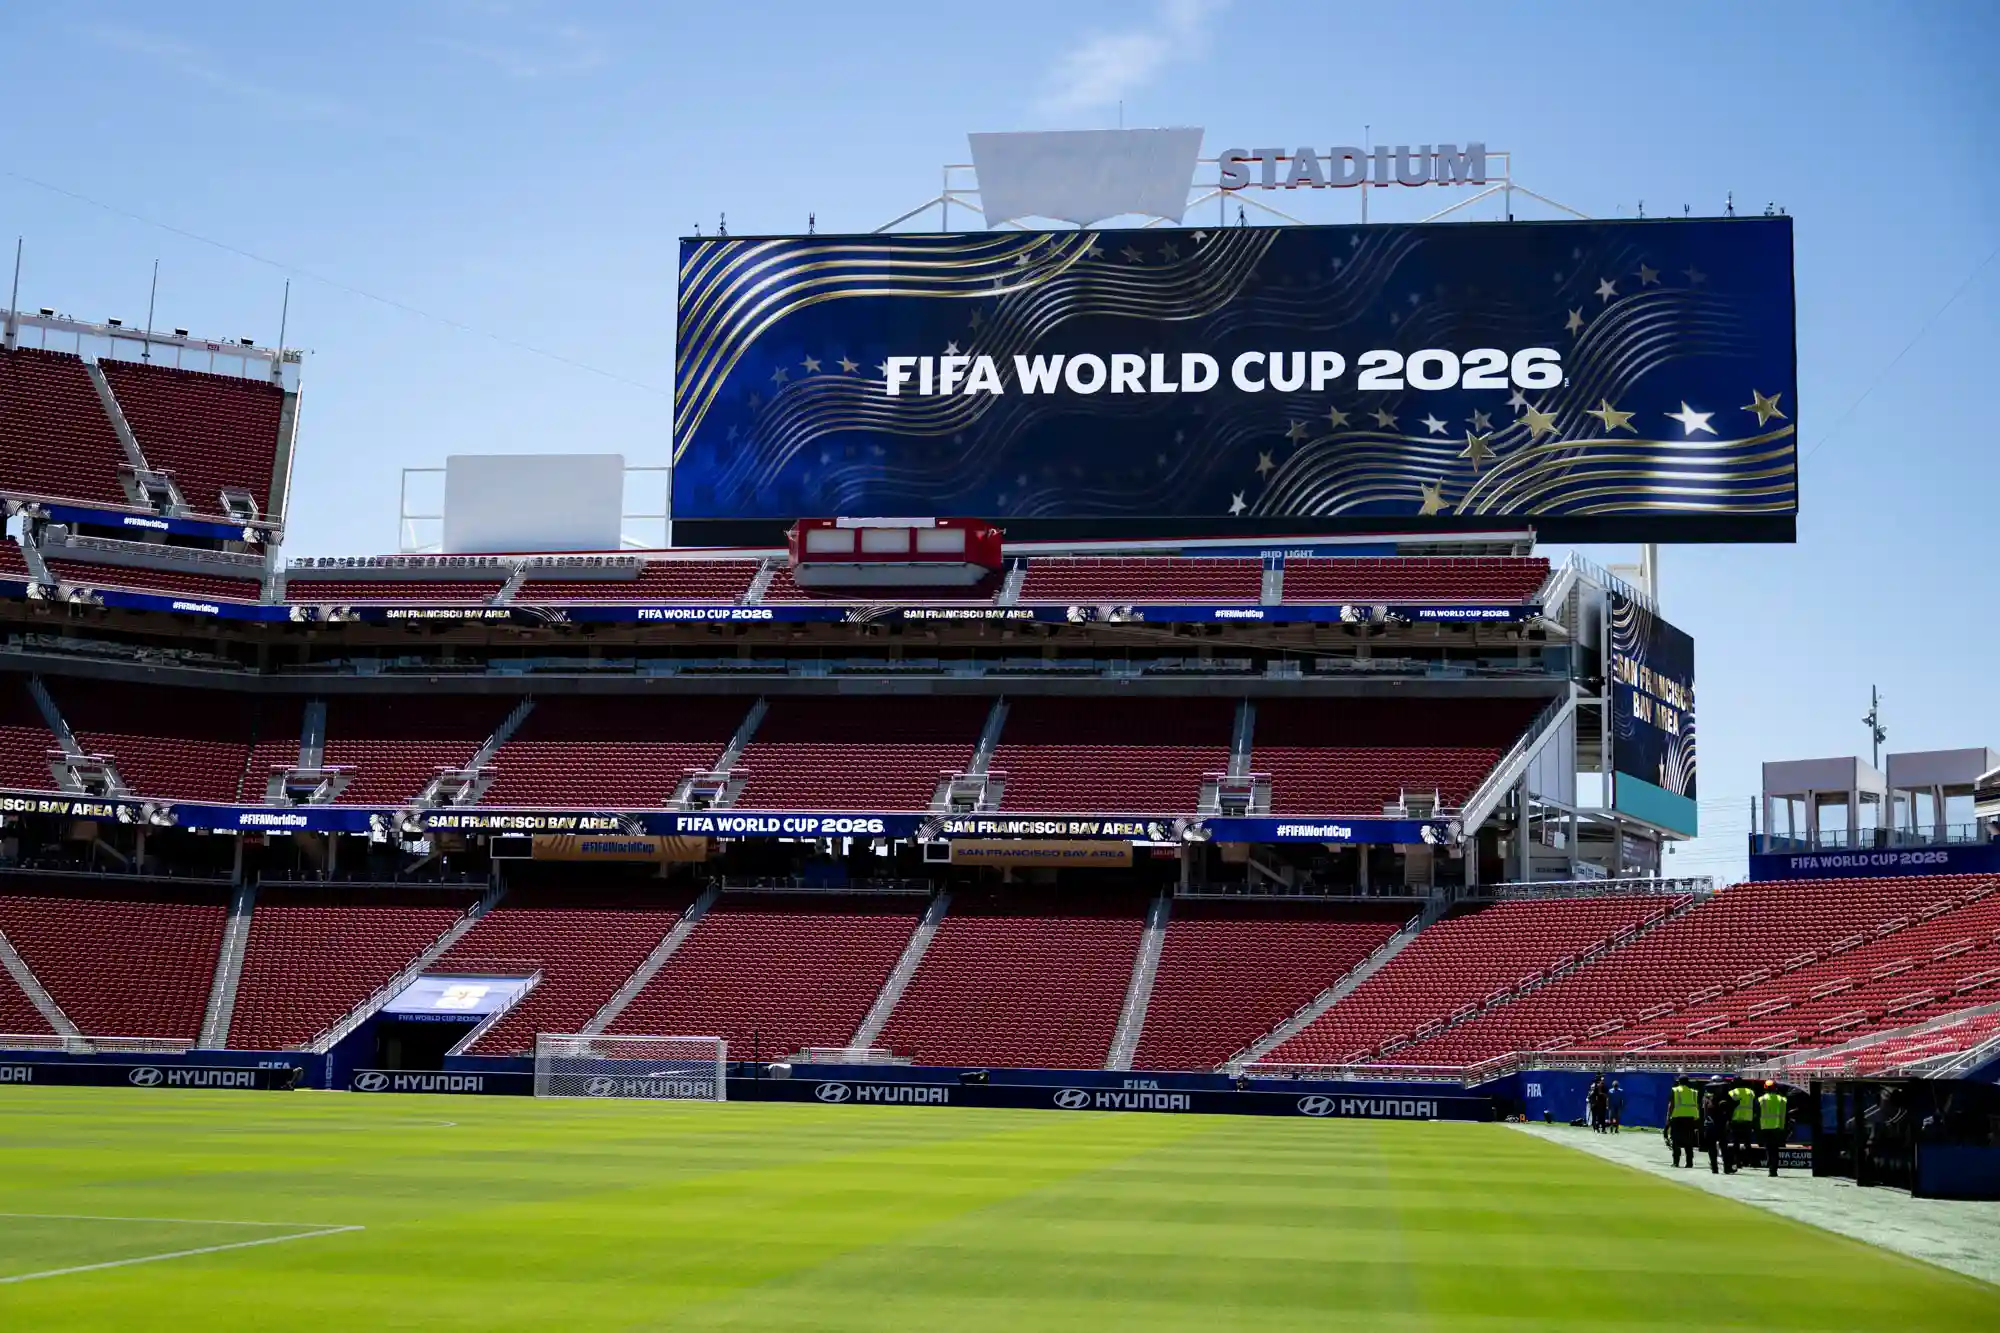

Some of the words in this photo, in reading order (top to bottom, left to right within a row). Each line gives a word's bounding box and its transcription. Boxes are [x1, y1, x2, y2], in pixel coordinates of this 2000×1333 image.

[1219, 141, 1486, 190] STADIUM
[886, 355, 1004, 395] FIFA
[1013, 353, 1220, 394] WORLD
[1231, 350, 1346, 392] CUP
[1357, 347, 1563, 391] 2026
[123, 517, 169, 530] #FIFAWorldCup
[172, 601, 219, 614] #FIFAWorldCup
[387, 610, 407, 618] SAN
[408, 610, 462, 619] FRANCISCO
[464, 610, 483, 618] BAY
[484, 610, 511, 618] AREA
[638, 609, 663, 619] FIFA
[664, 609, 706, 619] WORLD
[707, 609, 731, 619] CUP
[731, 609, 772, 619] 2026
[904, 610, 924, 618] SAN
[926, 610, 984, 619] FRANCISCO
[985, 610, 1006, 619] BAY
[1006, 610, 1034, 619] AREA
[1215, 609, 1264, 619] #FIFAWorldCup
[1615, 652, 1639, 687] SAN
[1640, 664, 1694, 713] FRANCISCO
[1633, 691, 1653, 724] BAY
[1655, 702, 1680, 737] AREA
[38, 801, 70, 815] BAY
[71, 803, 114, 818] AREA
[239, 814, 308, 827] #FIFAWorldCup
[428, 815, 459, 828] SAN
[461, 816, 545, 829] FRANCISCO
[547, 817, 577, 829] BAY
[579, 817, 620, 829] AREA
[677, 817, 714, 832] FIFA
[717, 817, 780, 832] WORLD
[783, 817, 819, 832] CUP
[821, 818, 884, 832] 2026
[943, 820, 975, 833] SAN
[978, 821, 1067, 834] FRANCISCO
[1069, 822, 1100, 834] BAY
[1102, 822, 1145, 835] AREA
[1276, 824, 1352, 839] #FIFAWorldCup
[581, 841, 655, 856] #FIFAWorldCup
[956, 849, 985, 858] SAN
[986, 849, 1061, 858] FRANCISCO
[1062, 850, 1088, 858] BAY
[1090, 850, 1126, 859] AREA
[1791, 857, 1820, 869] FIFA
[1820, 855, 1869, 867] WORLD
[1871, 853, 1899, 866] CUP
[1899, 851, 1949, 864] 2026
[168, 1070, 255, 1086] HYUNDAI
[394, 1075, 484, 1091] HYUNDAI
[1123, 1079, 1159, 1089] FIFA
[623, 1081, 714, 1096] HYUNDAI
[856, 1086, 949, 1102] HYUNDAI
[1527, 1083, 1543, 1098] FIFA
[1096, 1092, 1190, 1110] HYUNDAI
[1341, 1099, 1438, 1117] HYUNDAI
